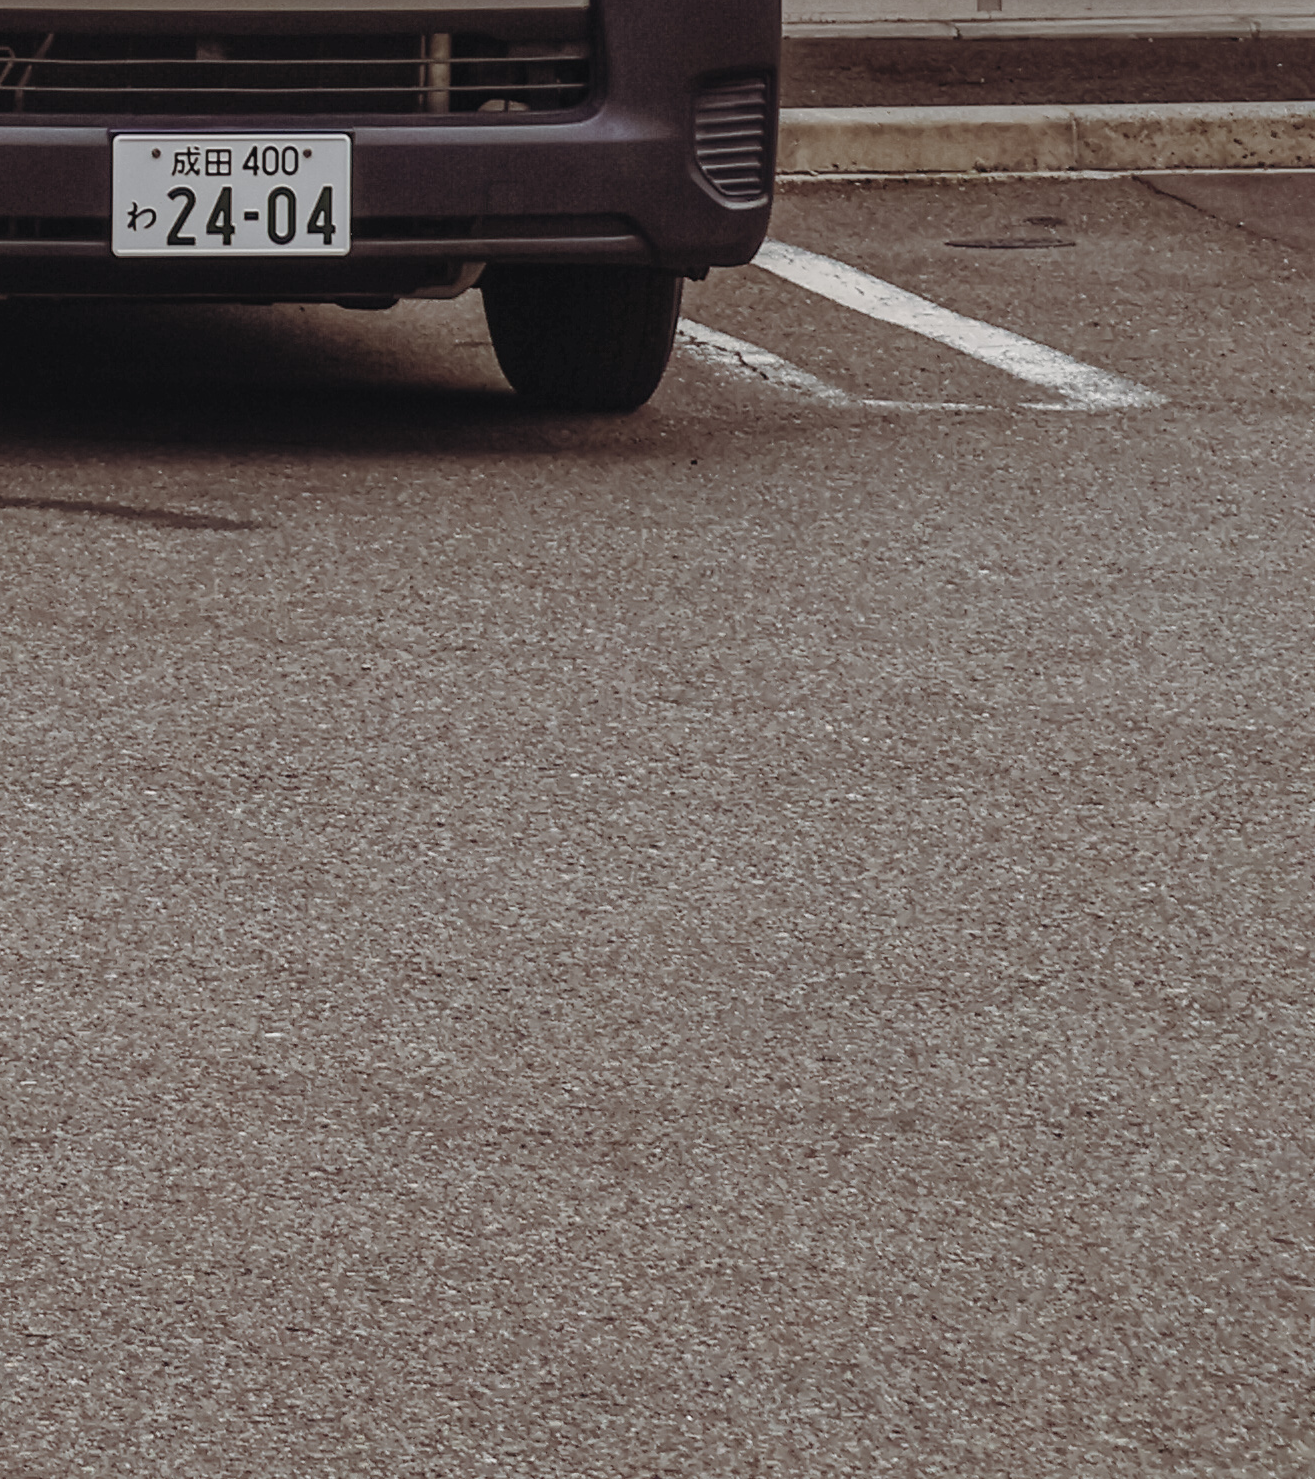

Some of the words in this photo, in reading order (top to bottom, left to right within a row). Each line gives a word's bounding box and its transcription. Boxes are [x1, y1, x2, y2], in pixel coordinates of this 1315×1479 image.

[171, 145, 232, 177] 成田
[242, 145, 299, 176] 400
[126, 201, 157, 232] わ
[166, 185, 337, 246] 24-04
